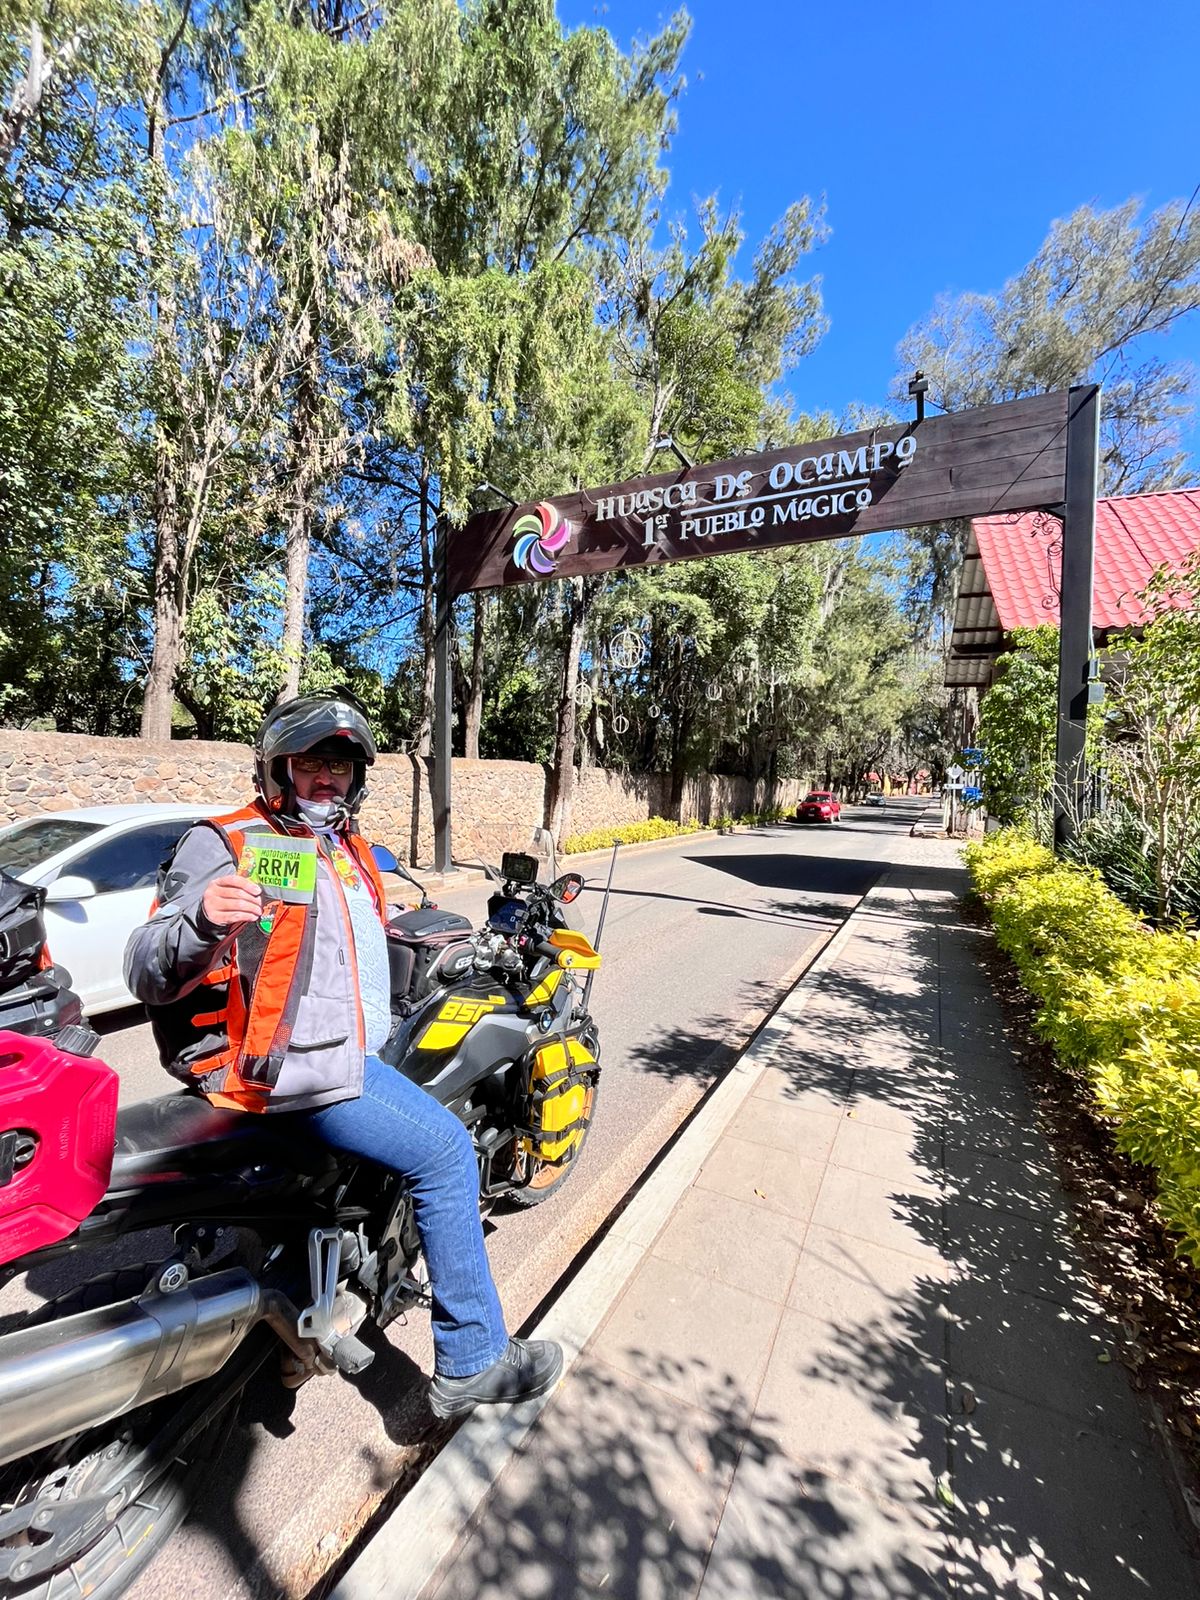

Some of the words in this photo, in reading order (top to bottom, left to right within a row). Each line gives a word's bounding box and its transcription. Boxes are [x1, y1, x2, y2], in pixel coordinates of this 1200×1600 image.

[641, 513, 672, 546] 1er
[261, 849, 300, 860] MOTOTURISTA
[258, 857, 300, 878] RRM
